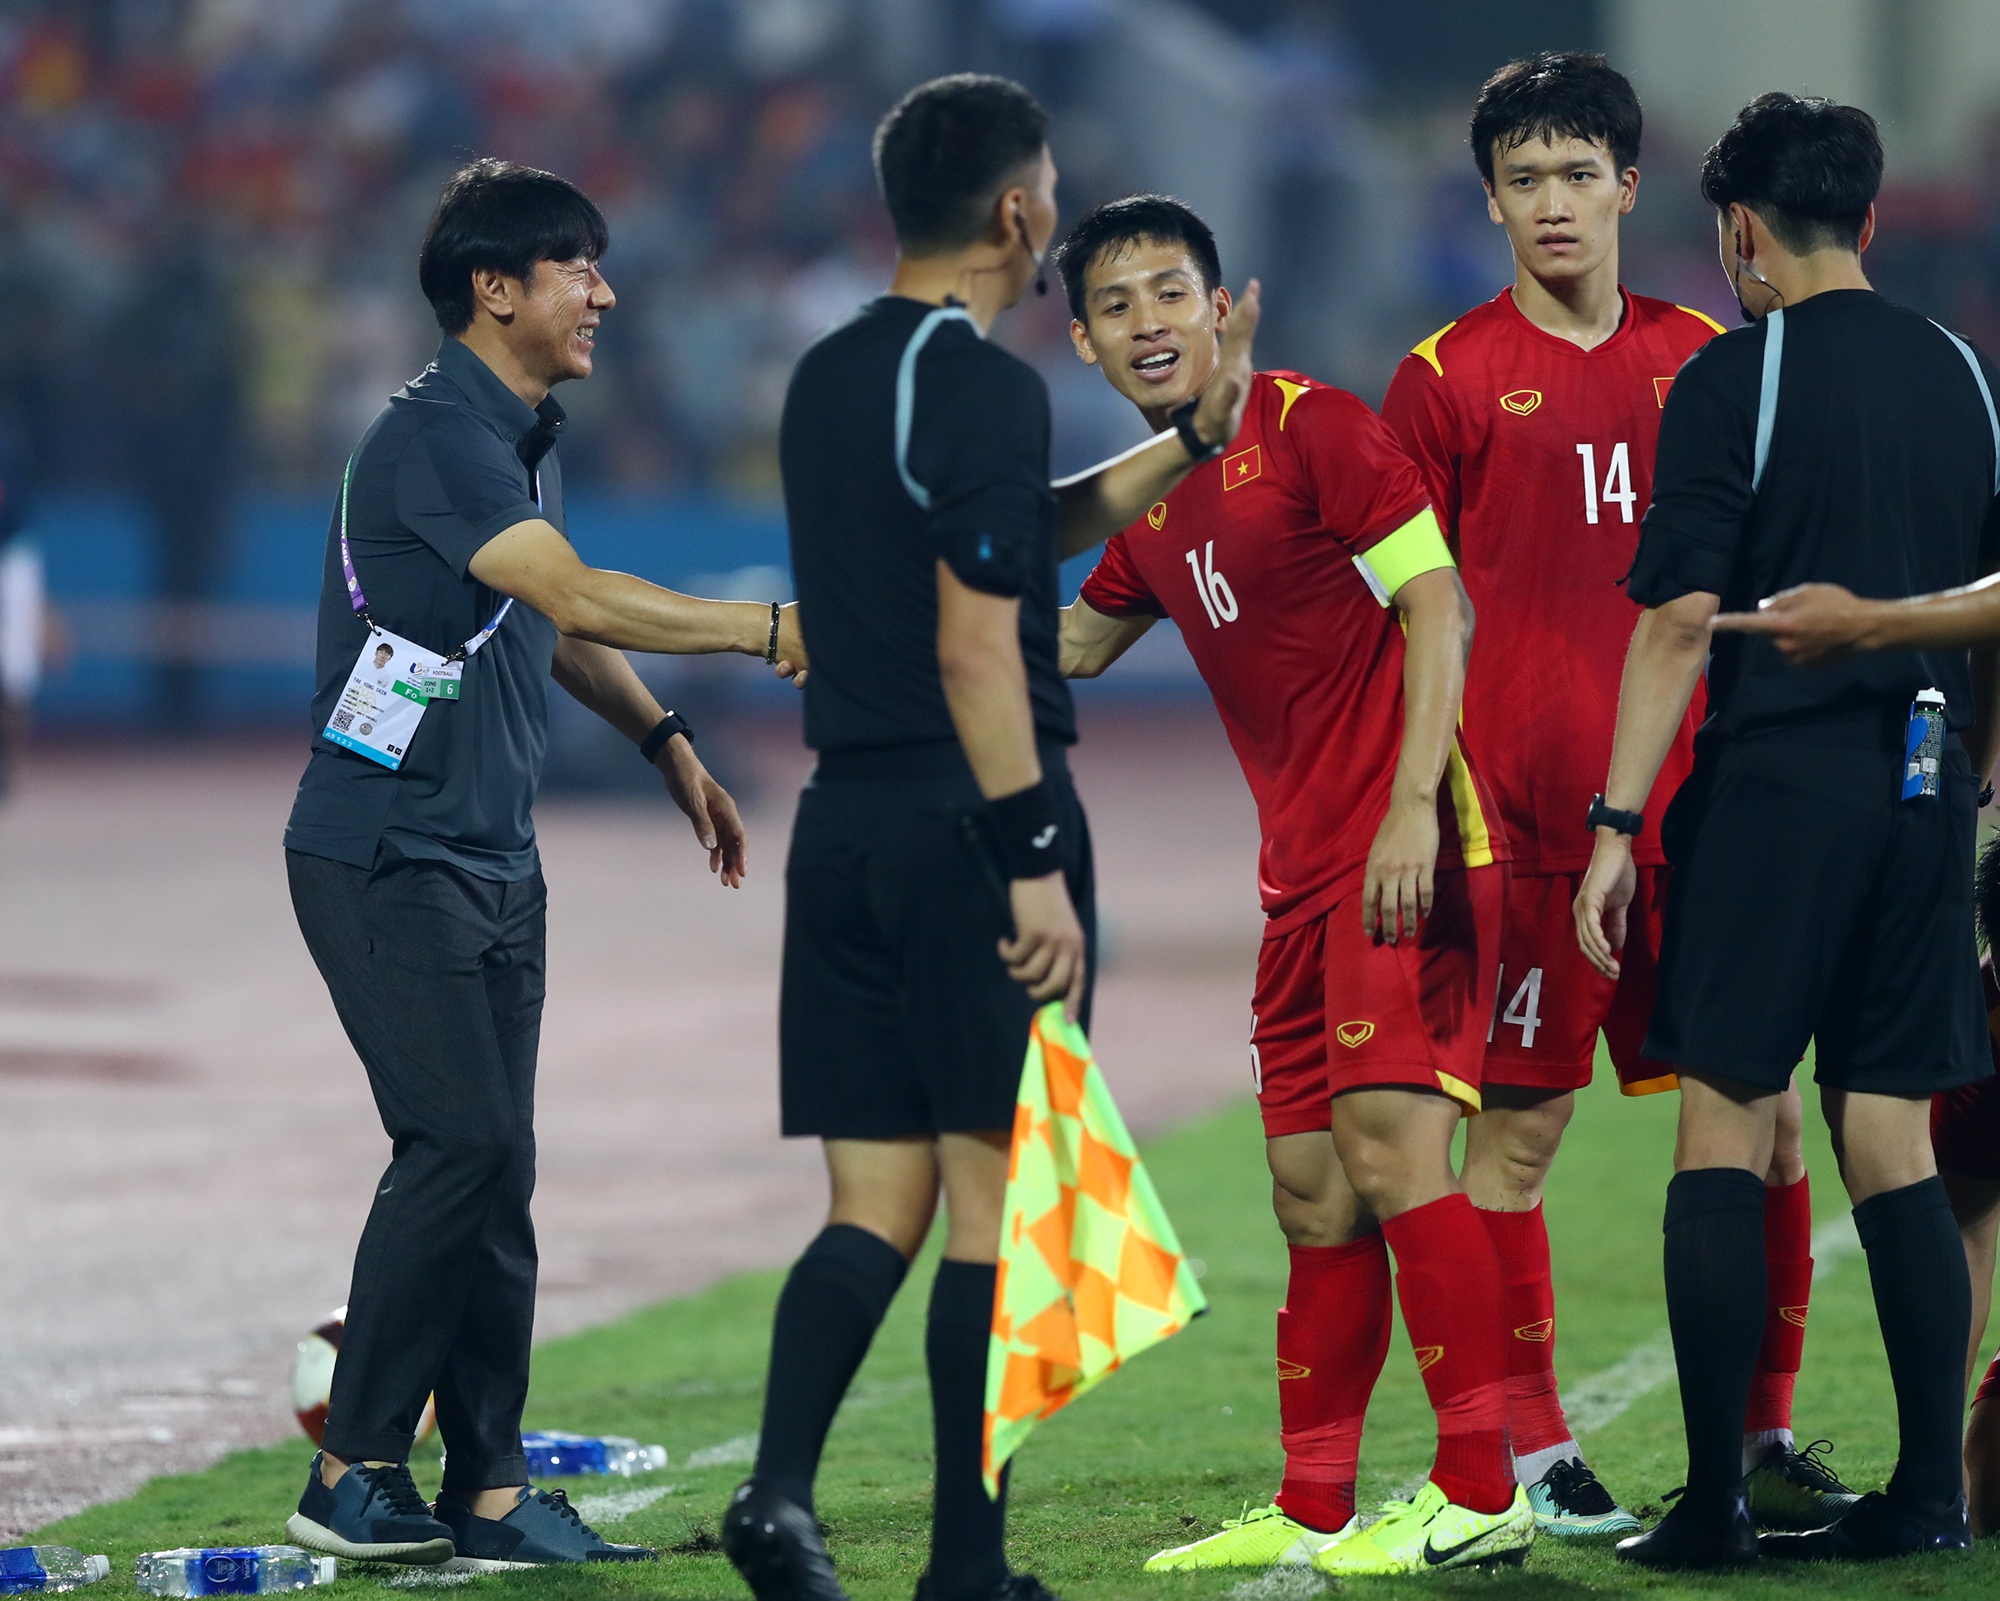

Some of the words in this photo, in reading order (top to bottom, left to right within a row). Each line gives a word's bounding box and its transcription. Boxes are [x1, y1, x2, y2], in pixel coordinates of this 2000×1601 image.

[1576, 443, 1637, 524] 14
[341, 542, 349, 567] ASIA
[1185, 540, 1239, 629] 16
[353, 677, 362, 685] TAE
[447, 684, 454, 695] 6
[405, 688, 417, 699] Fo
